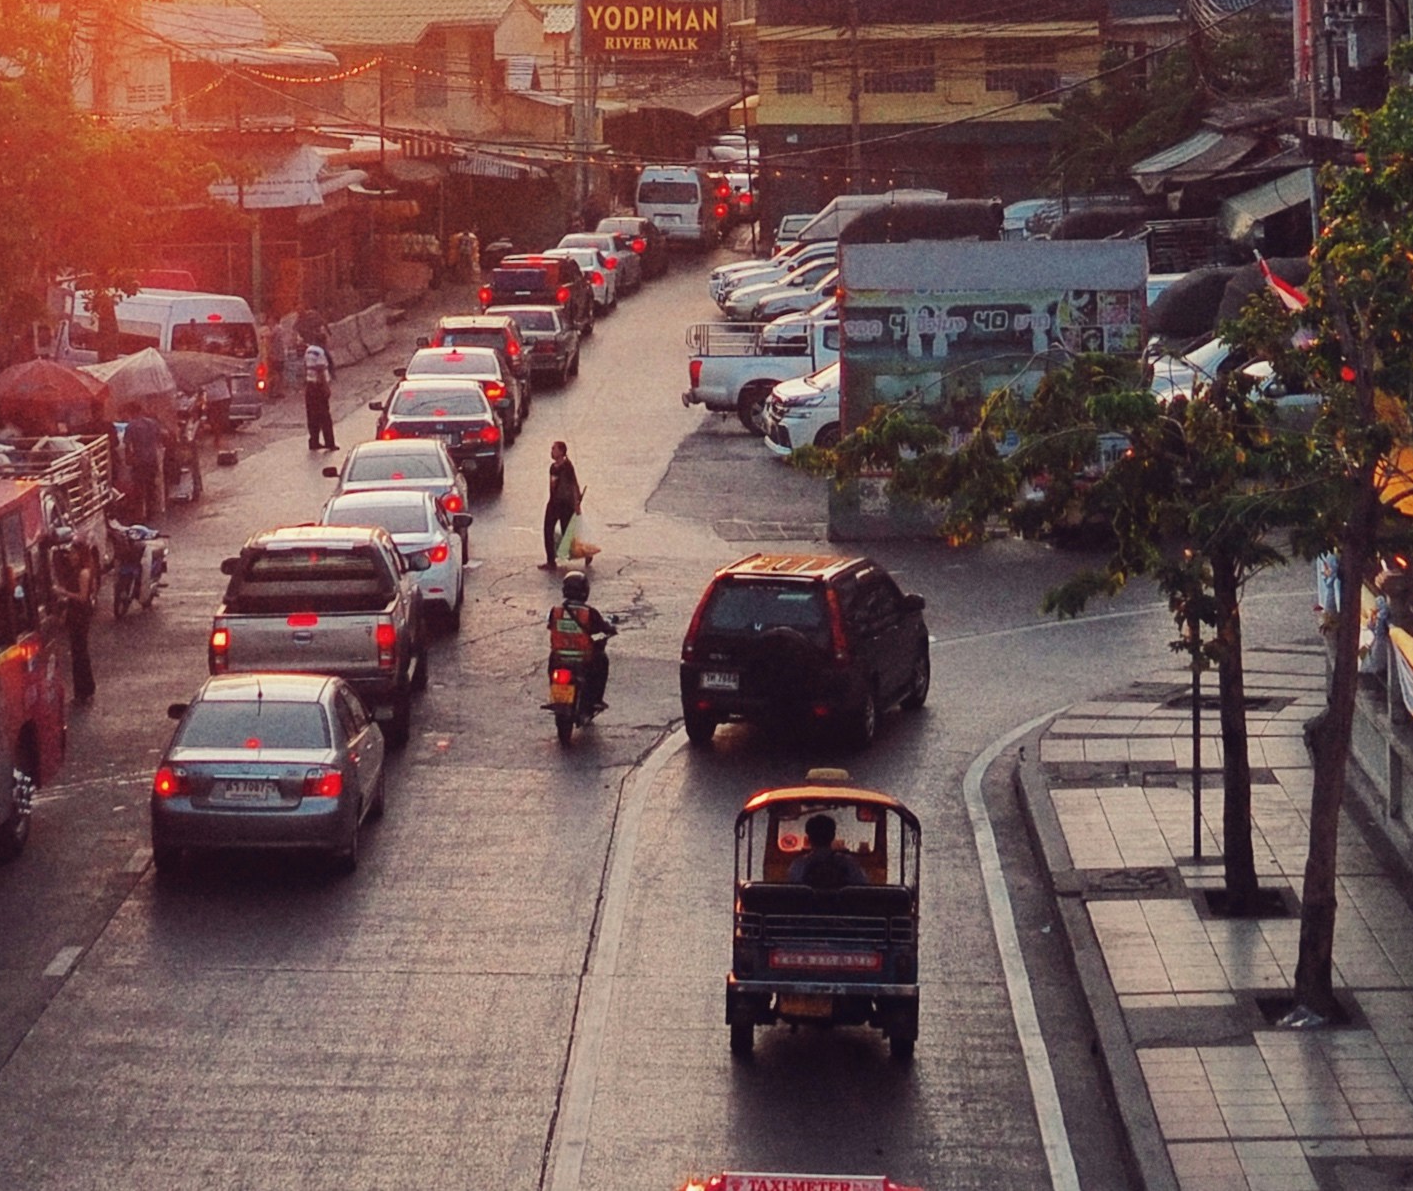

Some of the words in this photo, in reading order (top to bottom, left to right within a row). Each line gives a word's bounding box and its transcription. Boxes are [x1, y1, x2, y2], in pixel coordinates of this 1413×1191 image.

[587, 6, 718, 31] YODPIMAN
[604, 37, 651, 50] RIVER
[654, 37, 698, 50] WALK
[889, 313, 908, 335] 4
[973, 310, 1009, 331] 40
[748, 1179, 851, 1191] TAXI-METER
